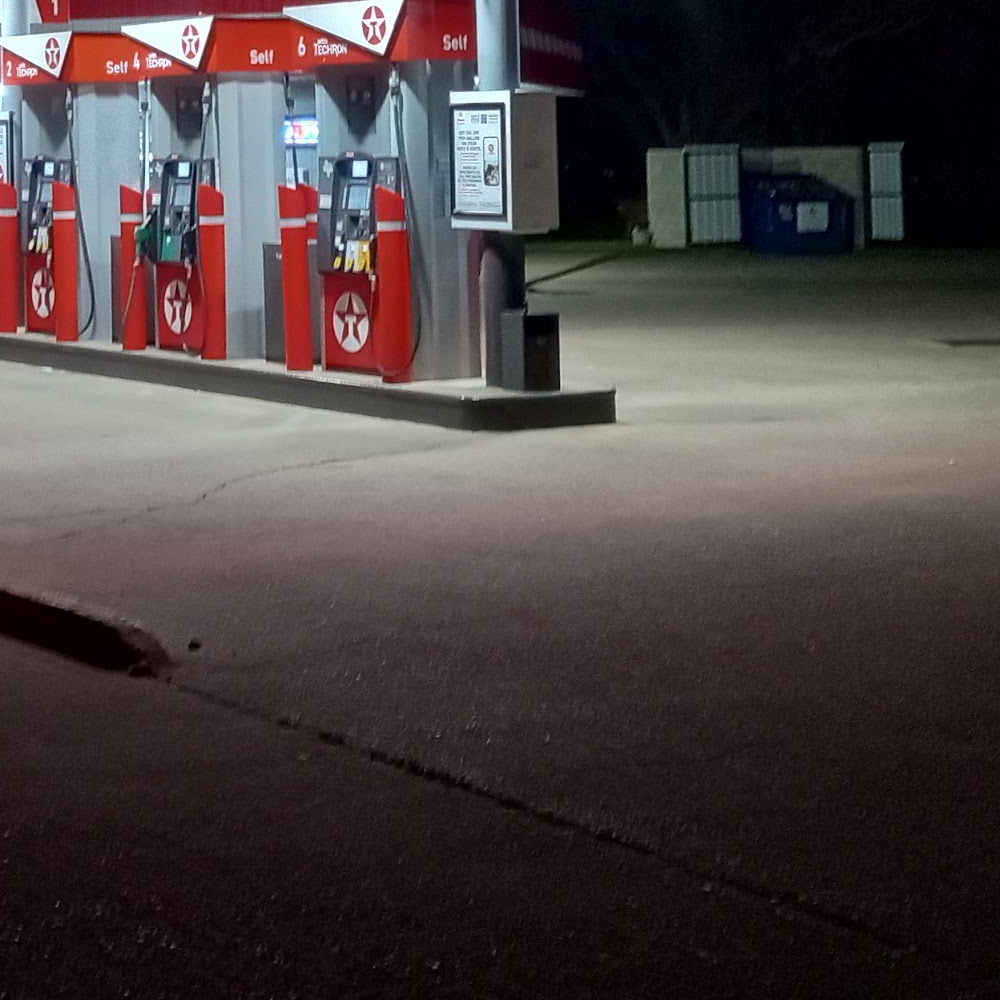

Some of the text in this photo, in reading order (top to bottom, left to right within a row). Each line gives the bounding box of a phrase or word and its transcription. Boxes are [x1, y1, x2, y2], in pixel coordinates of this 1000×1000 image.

[297, 35, 307, 57] 6
[313, 42, 348, 58] TECHRON
[442, 34, 468, 52] Self
[132, 51, 141, 70] 4
[249, 48, 274, 66] Self
[6, 60, 13, 78] 2
[105, 60, 129, 75] Self
